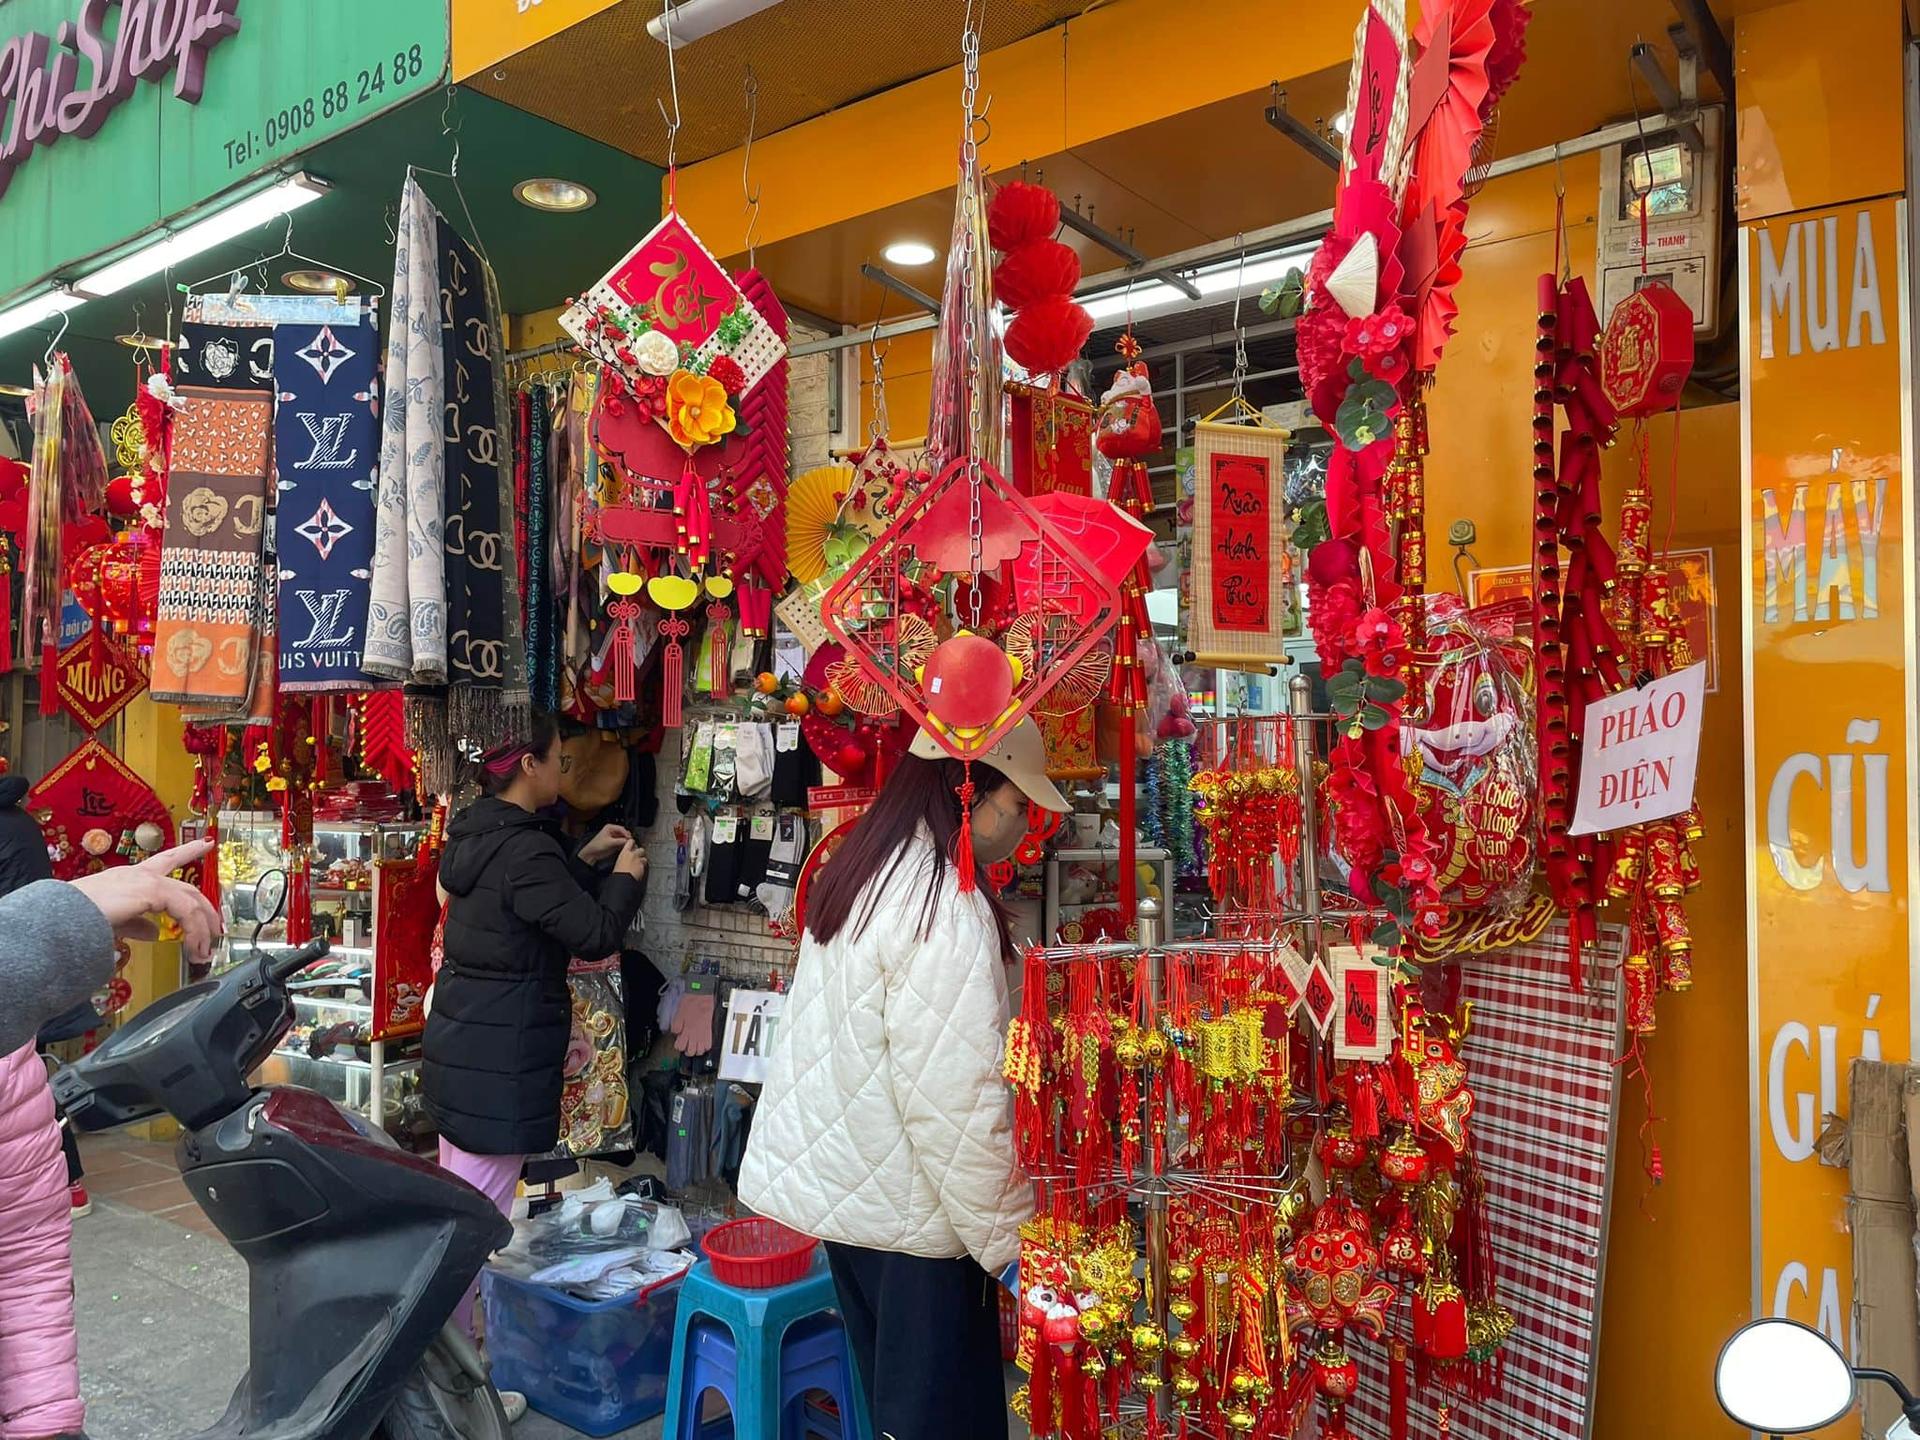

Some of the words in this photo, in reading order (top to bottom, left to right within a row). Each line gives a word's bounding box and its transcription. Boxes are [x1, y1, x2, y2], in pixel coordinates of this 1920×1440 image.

[224, 130, 260, 169] Tel:
[265, 97, 315, 148] 0908
[322, 80, 349, 119] 88
[356, 62, 385, 104] 24
[393, 43, 423, 85] 88
[1658, 234, 1686, 248] THANH
[648, 244, 723, 335] Tết
[1756, 209, 1887, 360] MUA
[1221, 482, 1262, 516] Xuân
[1217, 527, 1261, 561] Hạnh
[1760, 447, 1888, 624] MÁY
[1599, 689, 1686, 751] PHÁO
[1485, 781, 1520, 809] Chúc
[1598, 755, 1675, 809] ĐIỆN
[1767, 718, 1892, 893] CŨ
[1475, 833, 1508, 857] Năm
[1479, 806, 1518, 841] Mừng
[1480, 857, 1510, 882] Mới
[732, 1000, 781, 1058] TẤT
